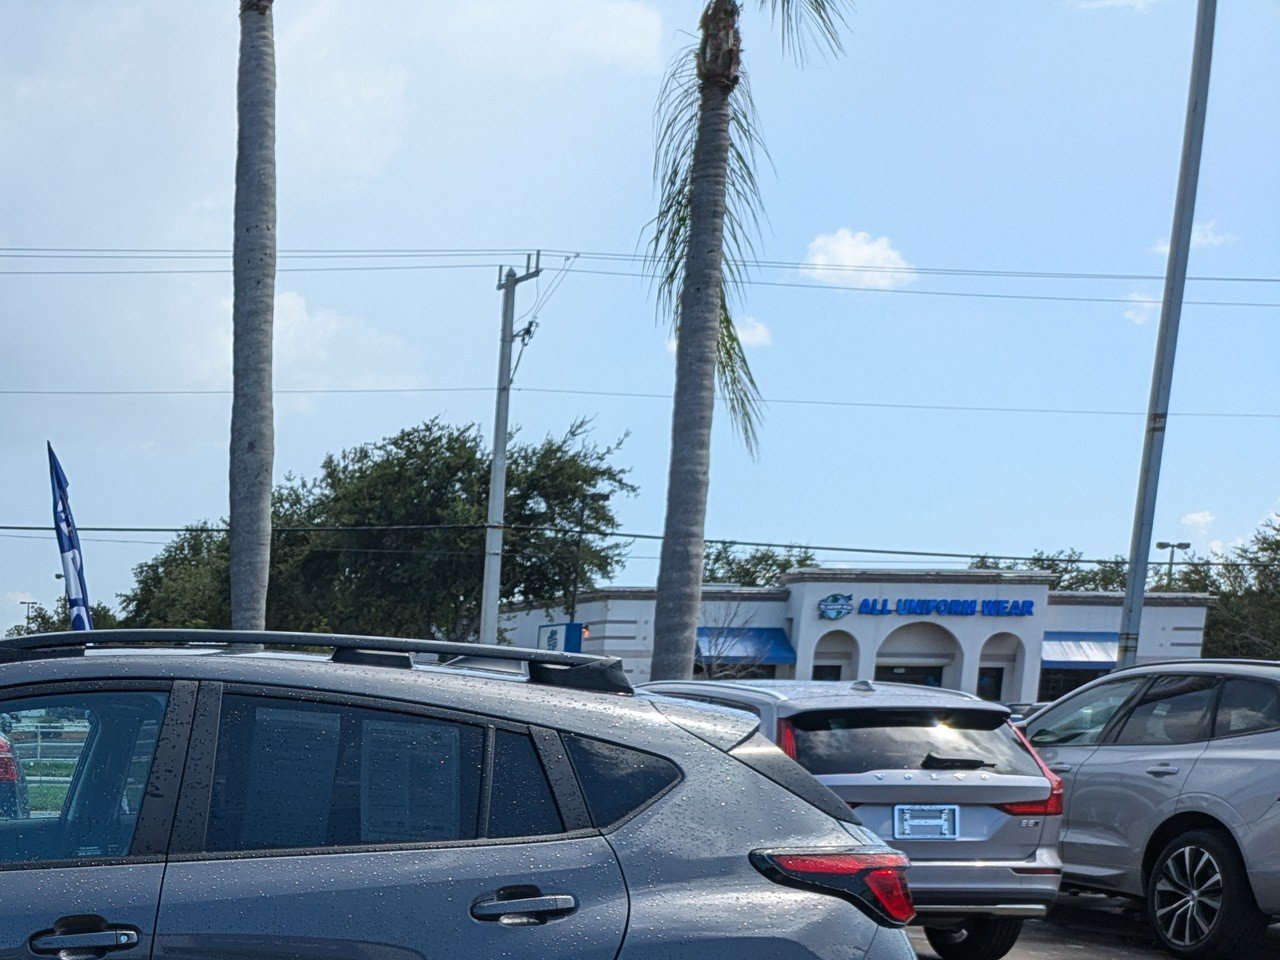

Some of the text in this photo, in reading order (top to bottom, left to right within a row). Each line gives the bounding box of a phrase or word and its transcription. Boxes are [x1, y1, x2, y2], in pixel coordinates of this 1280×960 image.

[858, 598, 892, 615] ALL
[896, 598, 977, 616] UNIFORM
[981, 599, 1034, 617] WEAR
